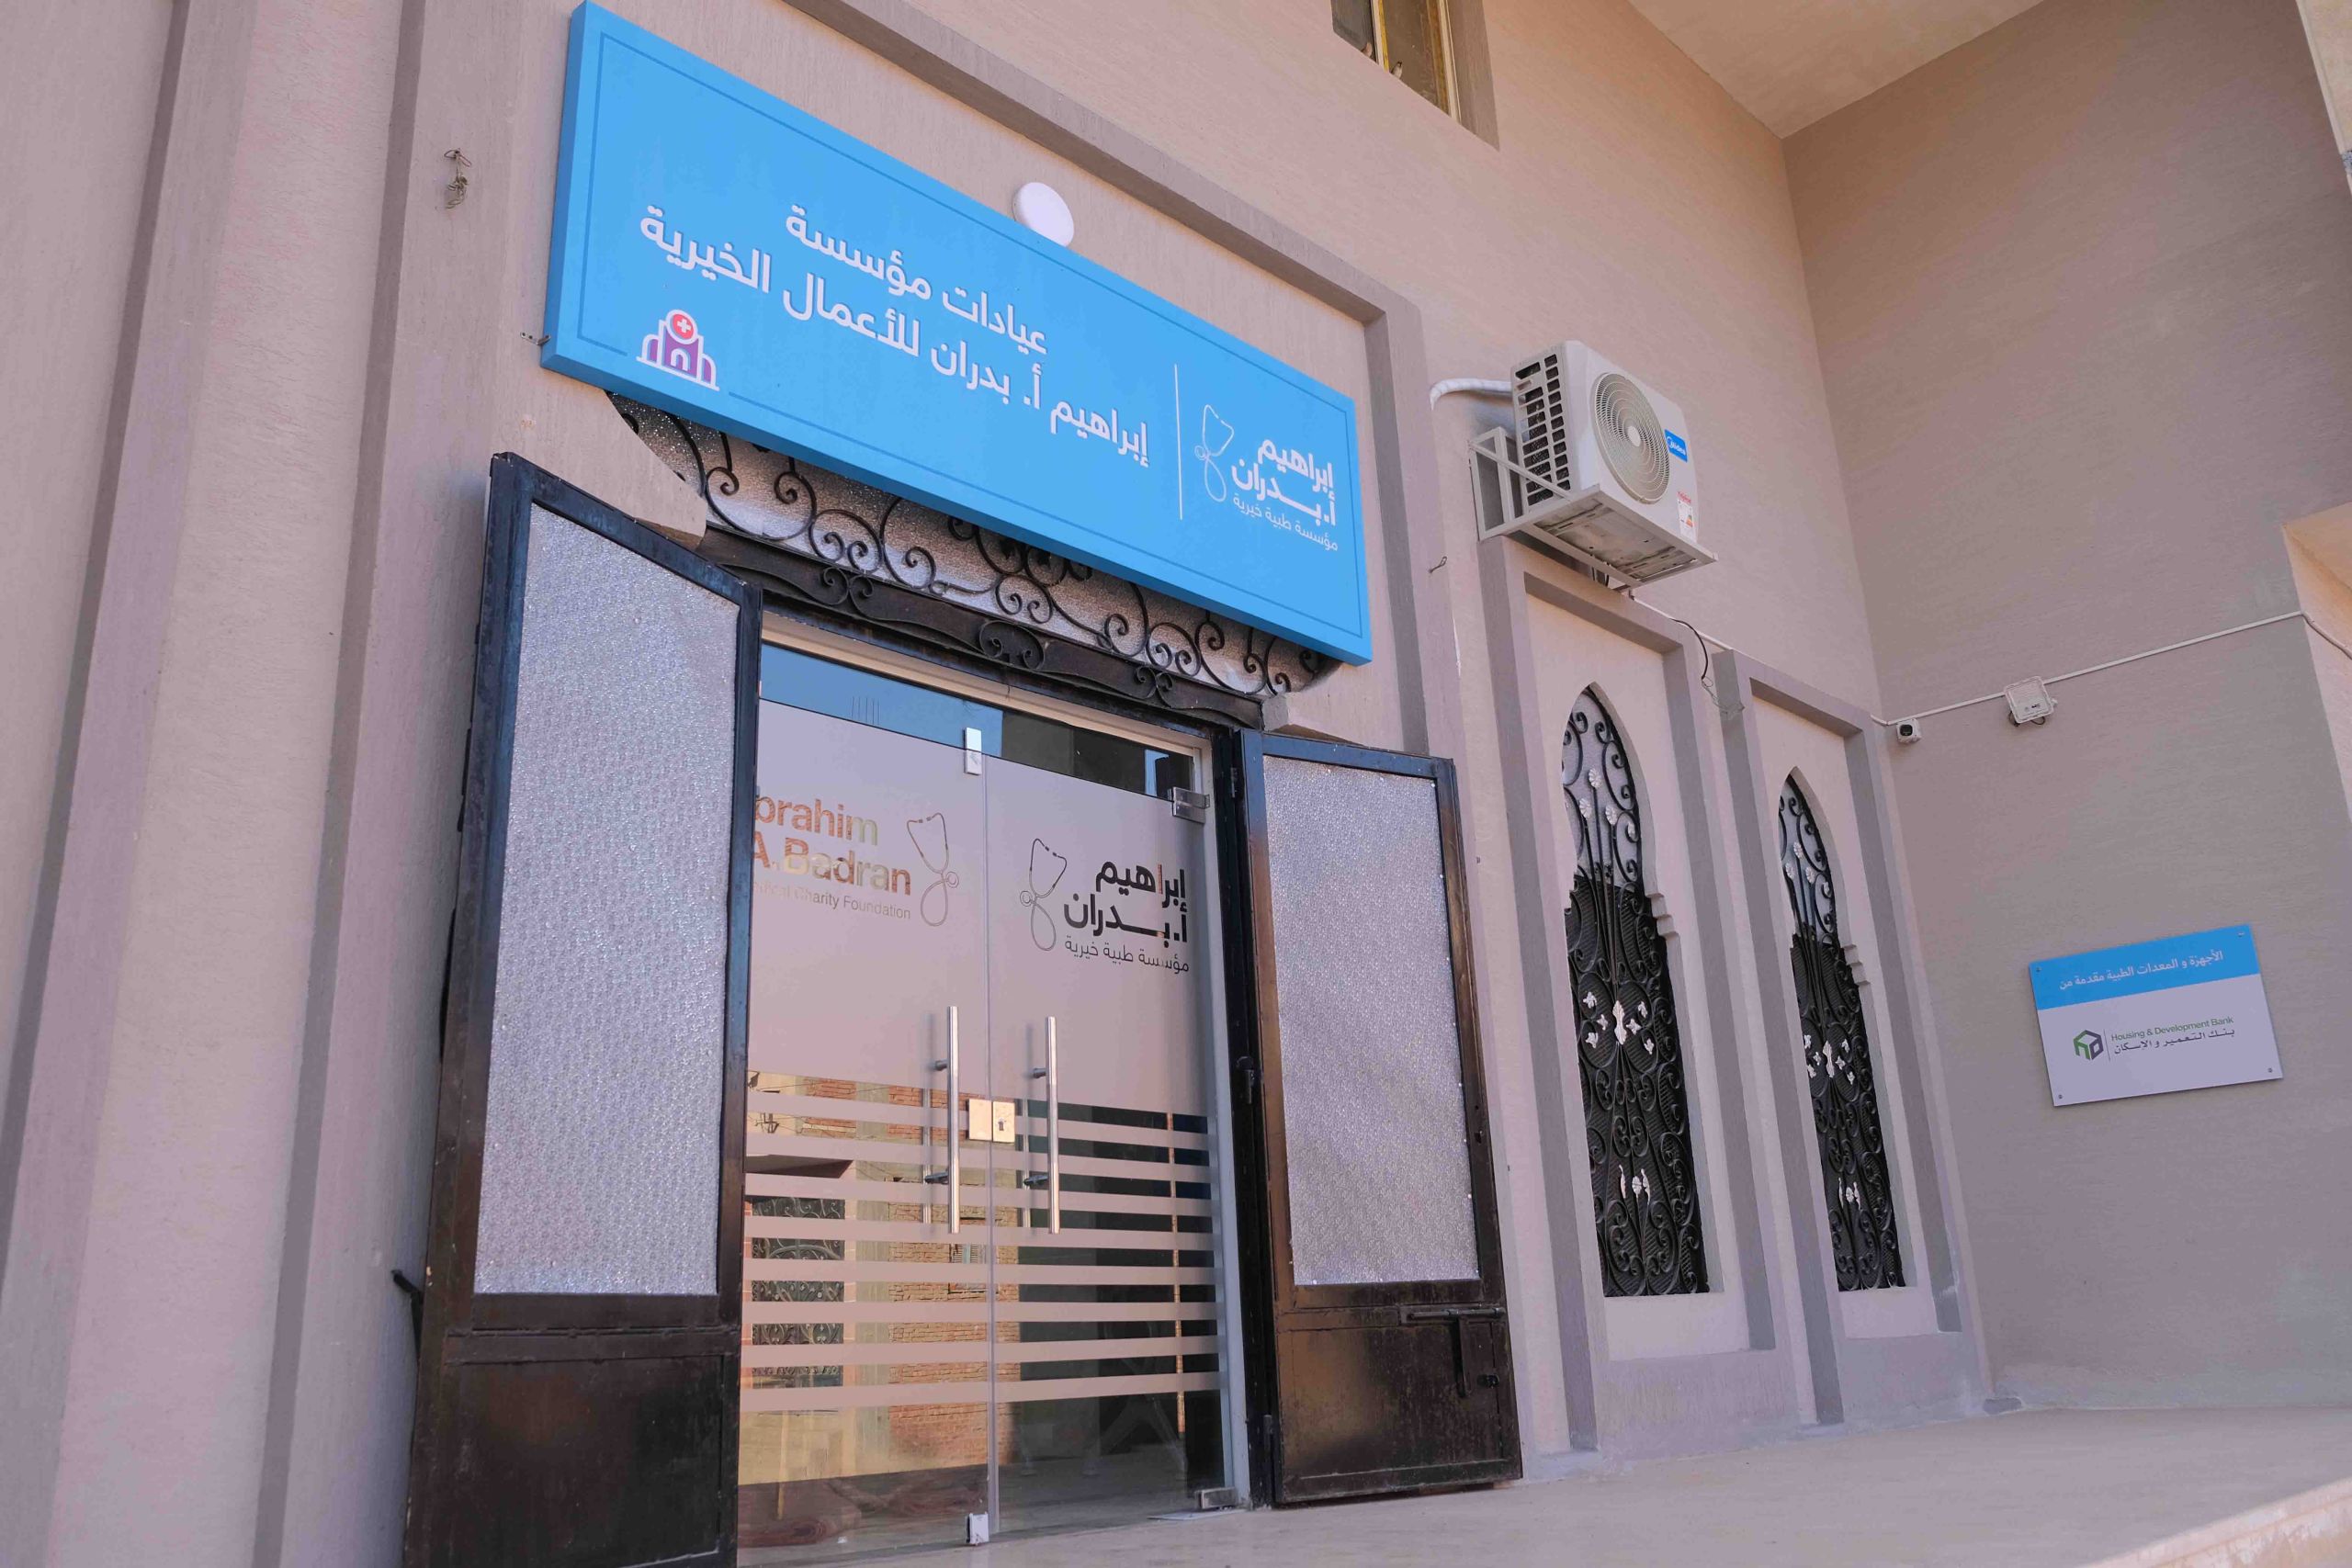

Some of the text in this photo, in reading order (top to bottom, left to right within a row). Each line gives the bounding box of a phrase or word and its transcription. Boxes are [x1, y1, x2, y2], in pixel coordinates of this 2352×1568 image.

[640, 205, 771, 293] الخيرية
[786, 206, 1047, 355] عيادات مؤسسة
[784, 273, 920, 357] للأعمال
[931, 342, 1011, 405] بدران
[1050, 402, 1149, 468] إبراهيم
[1233, 493, 1339, 551] مؤسسة طبية خيرية
[754, 786, 878, 846] brahim
[843, 896, 911, 919] Foundation
[1065, 935, 1190, 975] مؤسسة طبية خيرية
[2059, 949, 2224, 990] الأجهزة و المعدات الطبية مقدمة من
[2111, 1016, 2234, 1042] Housing & Development Bank
[2154, 1040, 2160, 1048] و
[2209, 1028, 2235, 1038] بنك
